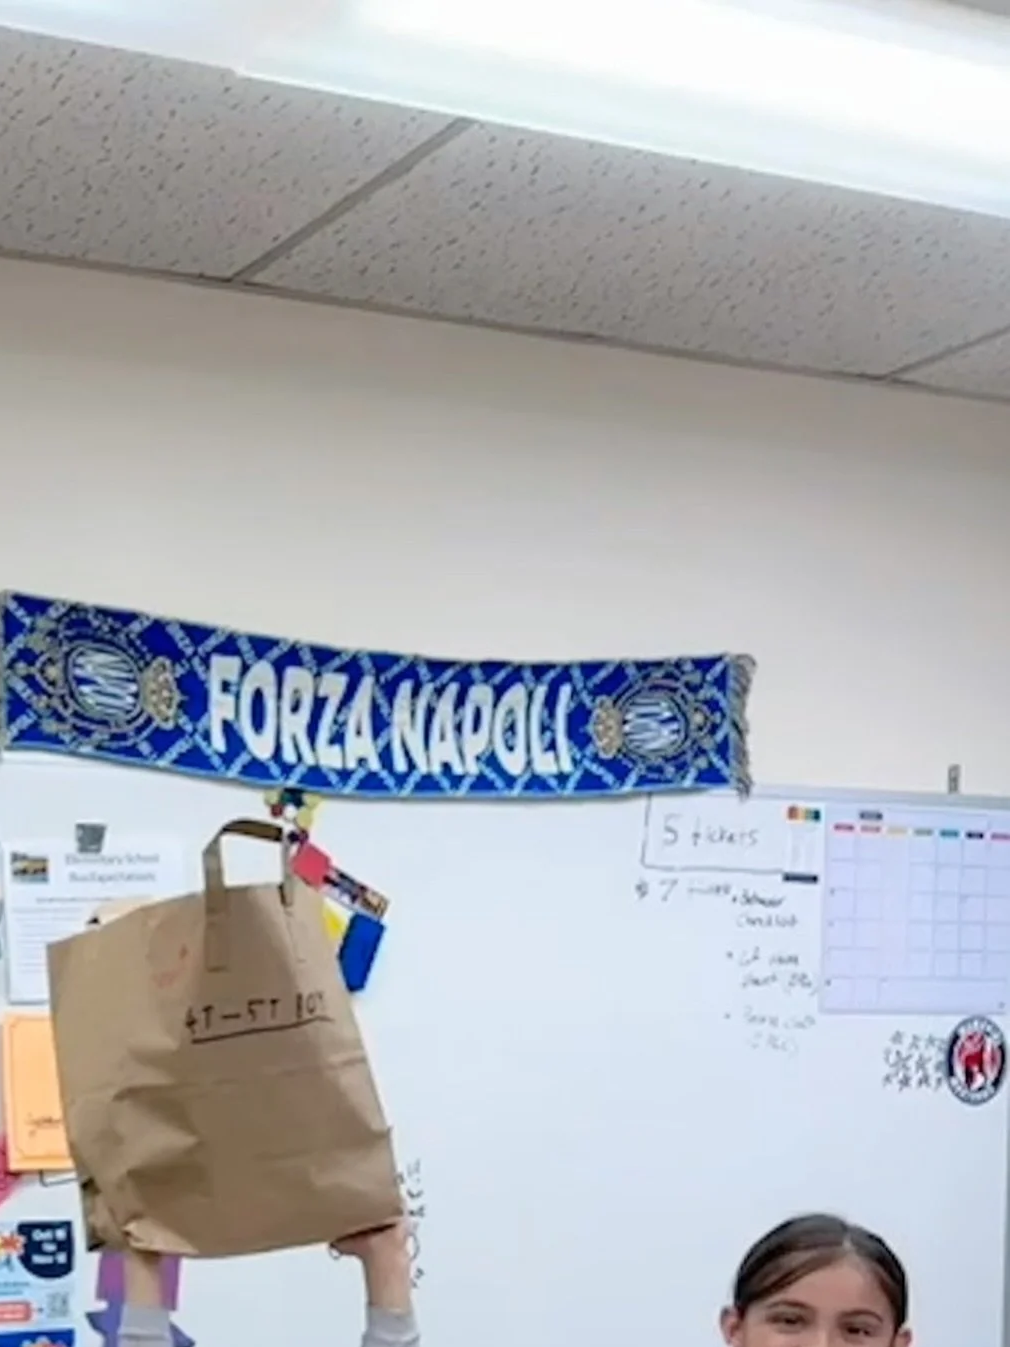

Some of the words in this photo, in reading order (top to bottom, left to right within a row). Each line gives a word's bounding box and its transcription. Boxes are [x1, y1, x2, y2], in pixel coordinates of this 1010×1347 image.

[209, 653, 381, 773] FORZA
[391, 678, 573, 776] NAPOLI
[663, 813, 683, 846] 5
[126, 852, 160, 863] School
[659, 878, 679, 902] 7
